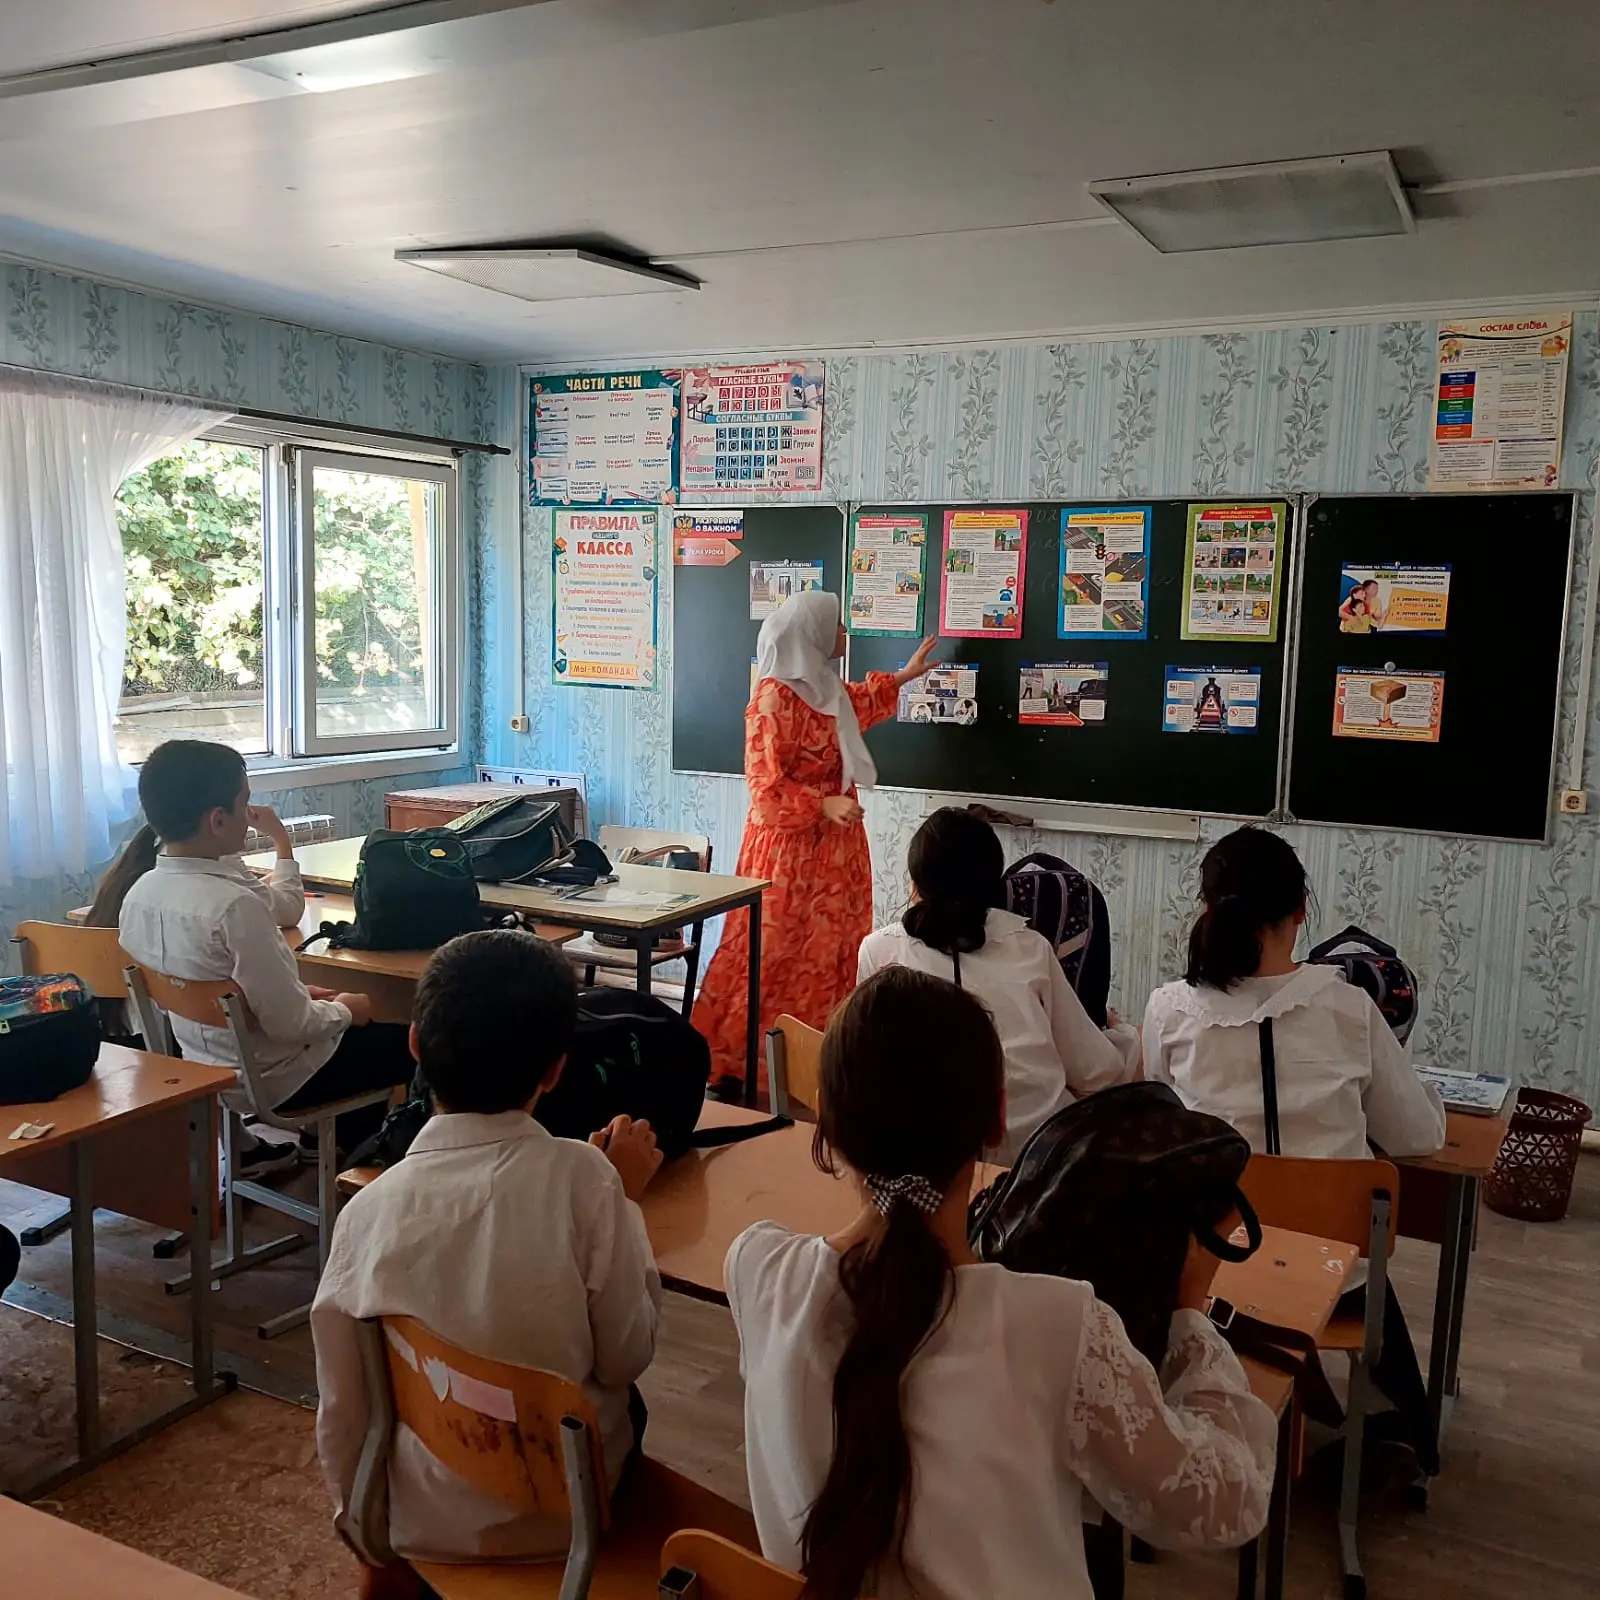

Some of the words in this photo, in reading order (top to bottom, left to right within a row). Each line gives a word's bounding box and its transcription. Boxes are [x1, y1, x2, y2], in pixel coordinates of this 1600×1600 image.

[1480, 324, 1514, 332] СОСТАВ
[1516, 322, 1548, 330] СЛОВА
[566, 378, 605, 391] ЧАСТИ
[610, 376, 642, 389] РЕЧИ
[718, 376, 756, 386] ГЛАСНЫЕ
[758, 374, 784, 384] БУКВЫ
[716, 414, 764, 422] СОГЛАСНЫЕ
[766, 412, 793, 420] БУКВЫ
[570, 516, 640, 530] ПРАВИЛА
[577, 542, 634, 556] КЛАССА
